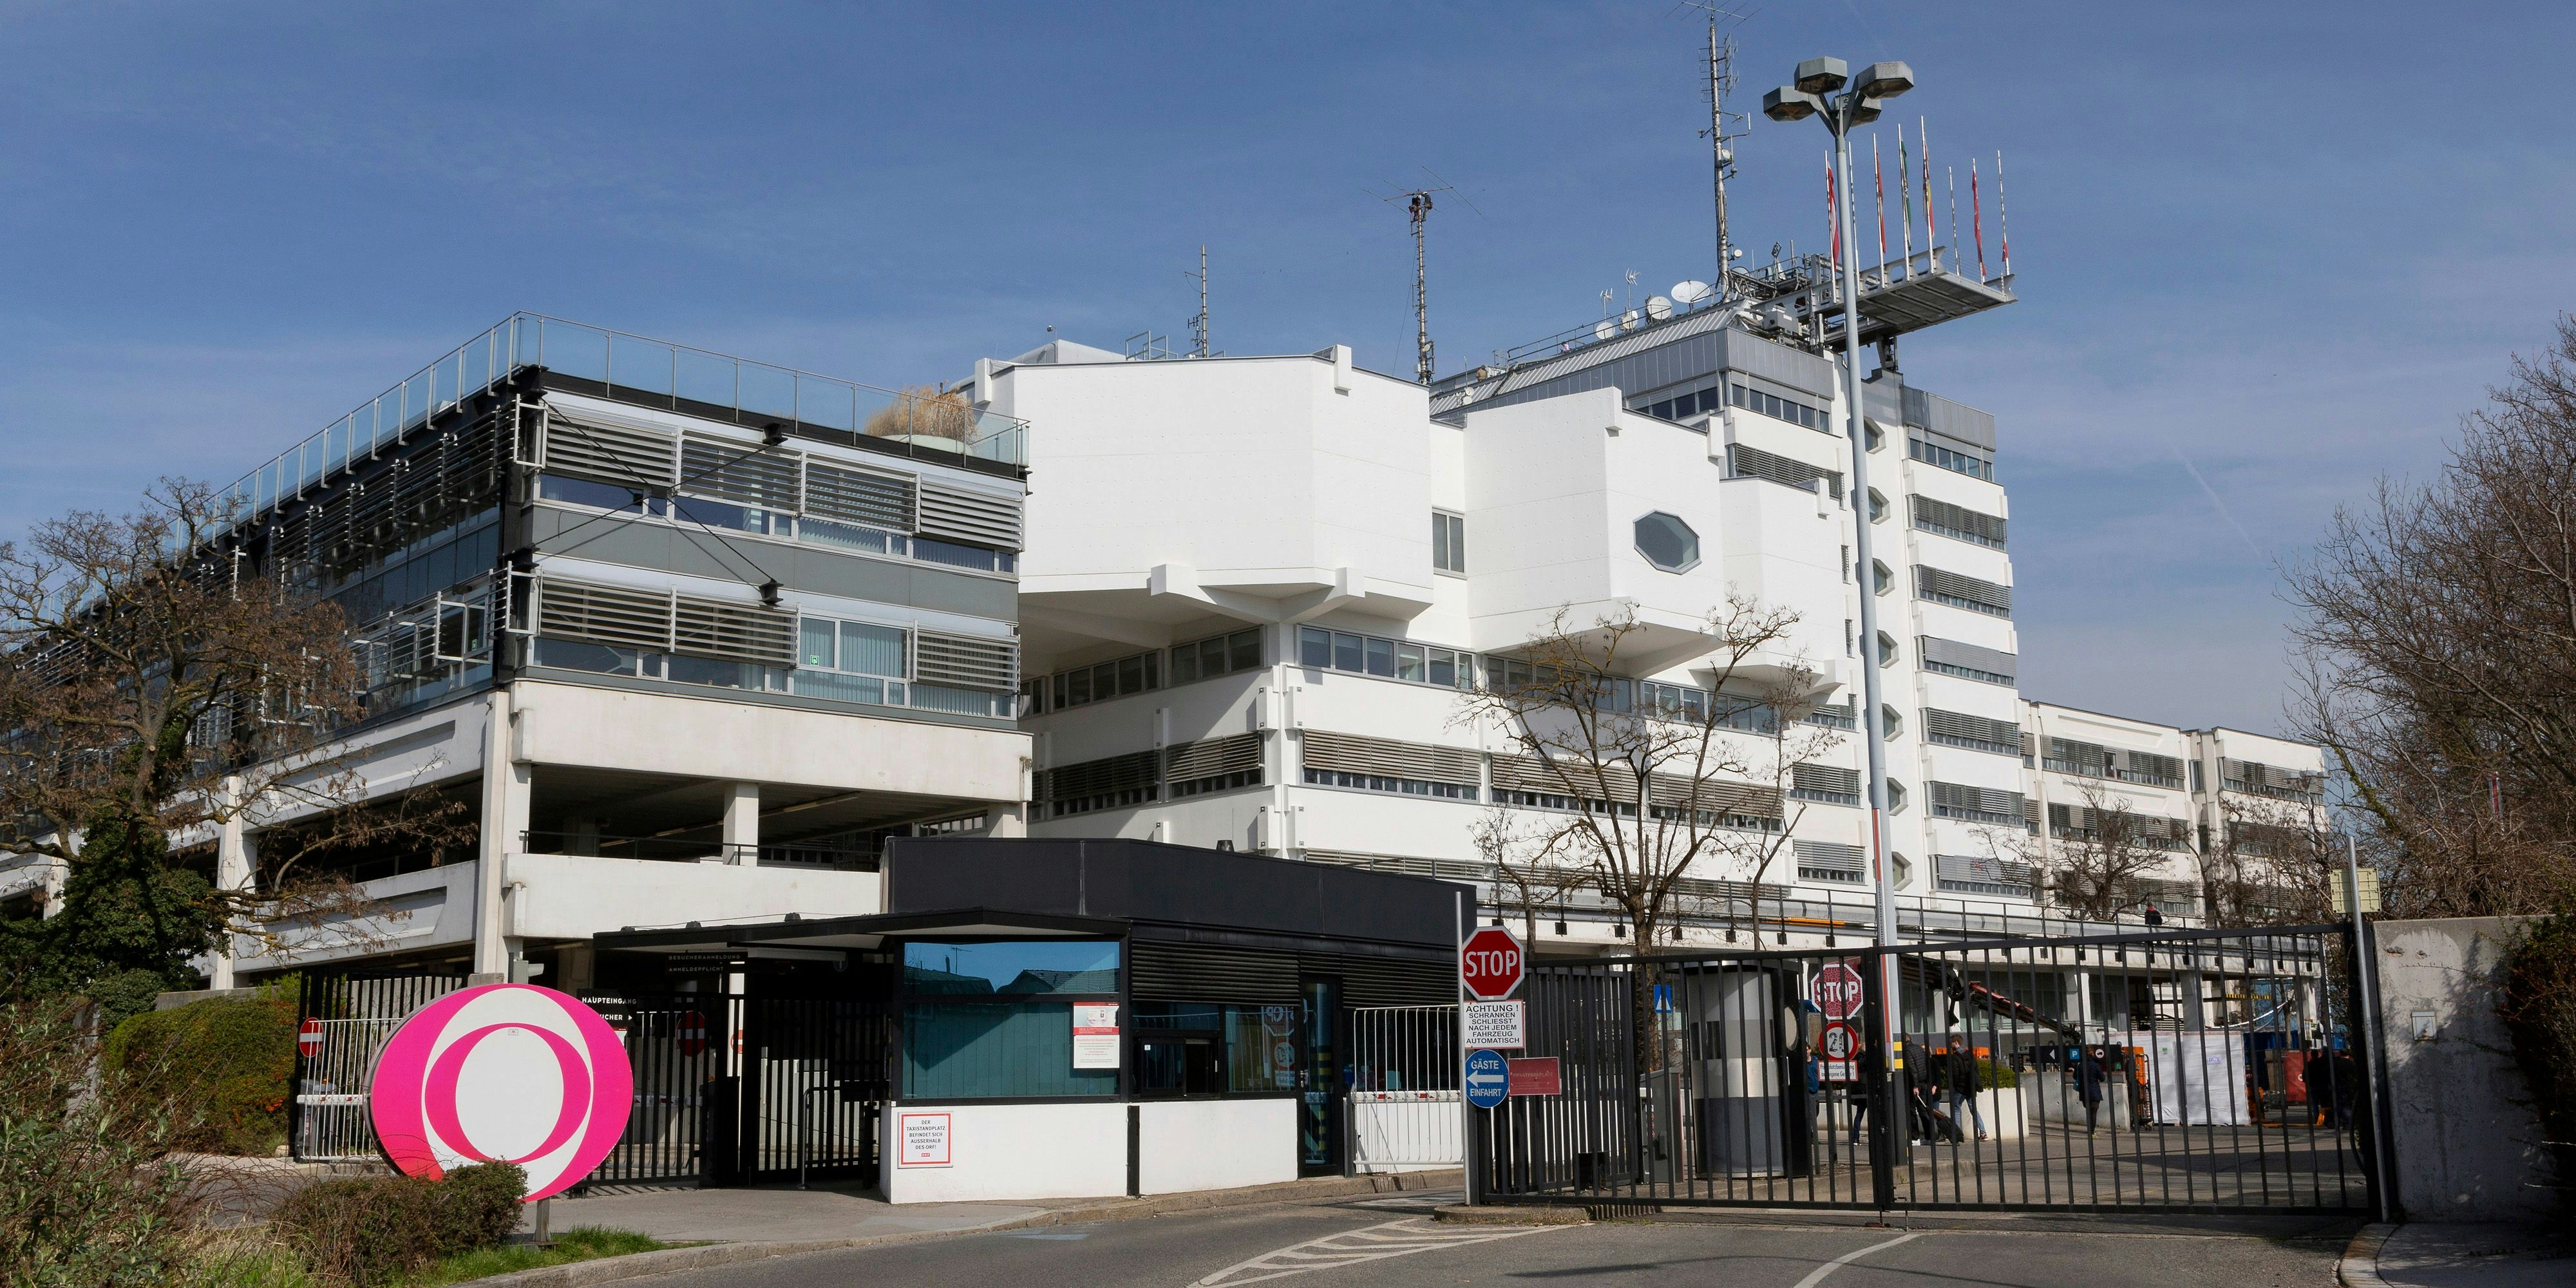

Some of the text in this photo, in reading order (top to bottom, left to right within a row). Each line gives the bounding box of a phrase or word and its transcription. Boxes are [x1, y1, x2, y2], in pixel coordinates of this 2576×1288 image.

[1465, 950, 1518, 977] STOP
[1817, 981, 1859, 1003] STOP
[1471, 1058, 1499, 1070] GÄSTE
[1470, 1088, 1502, 1097] EINFAHRT
